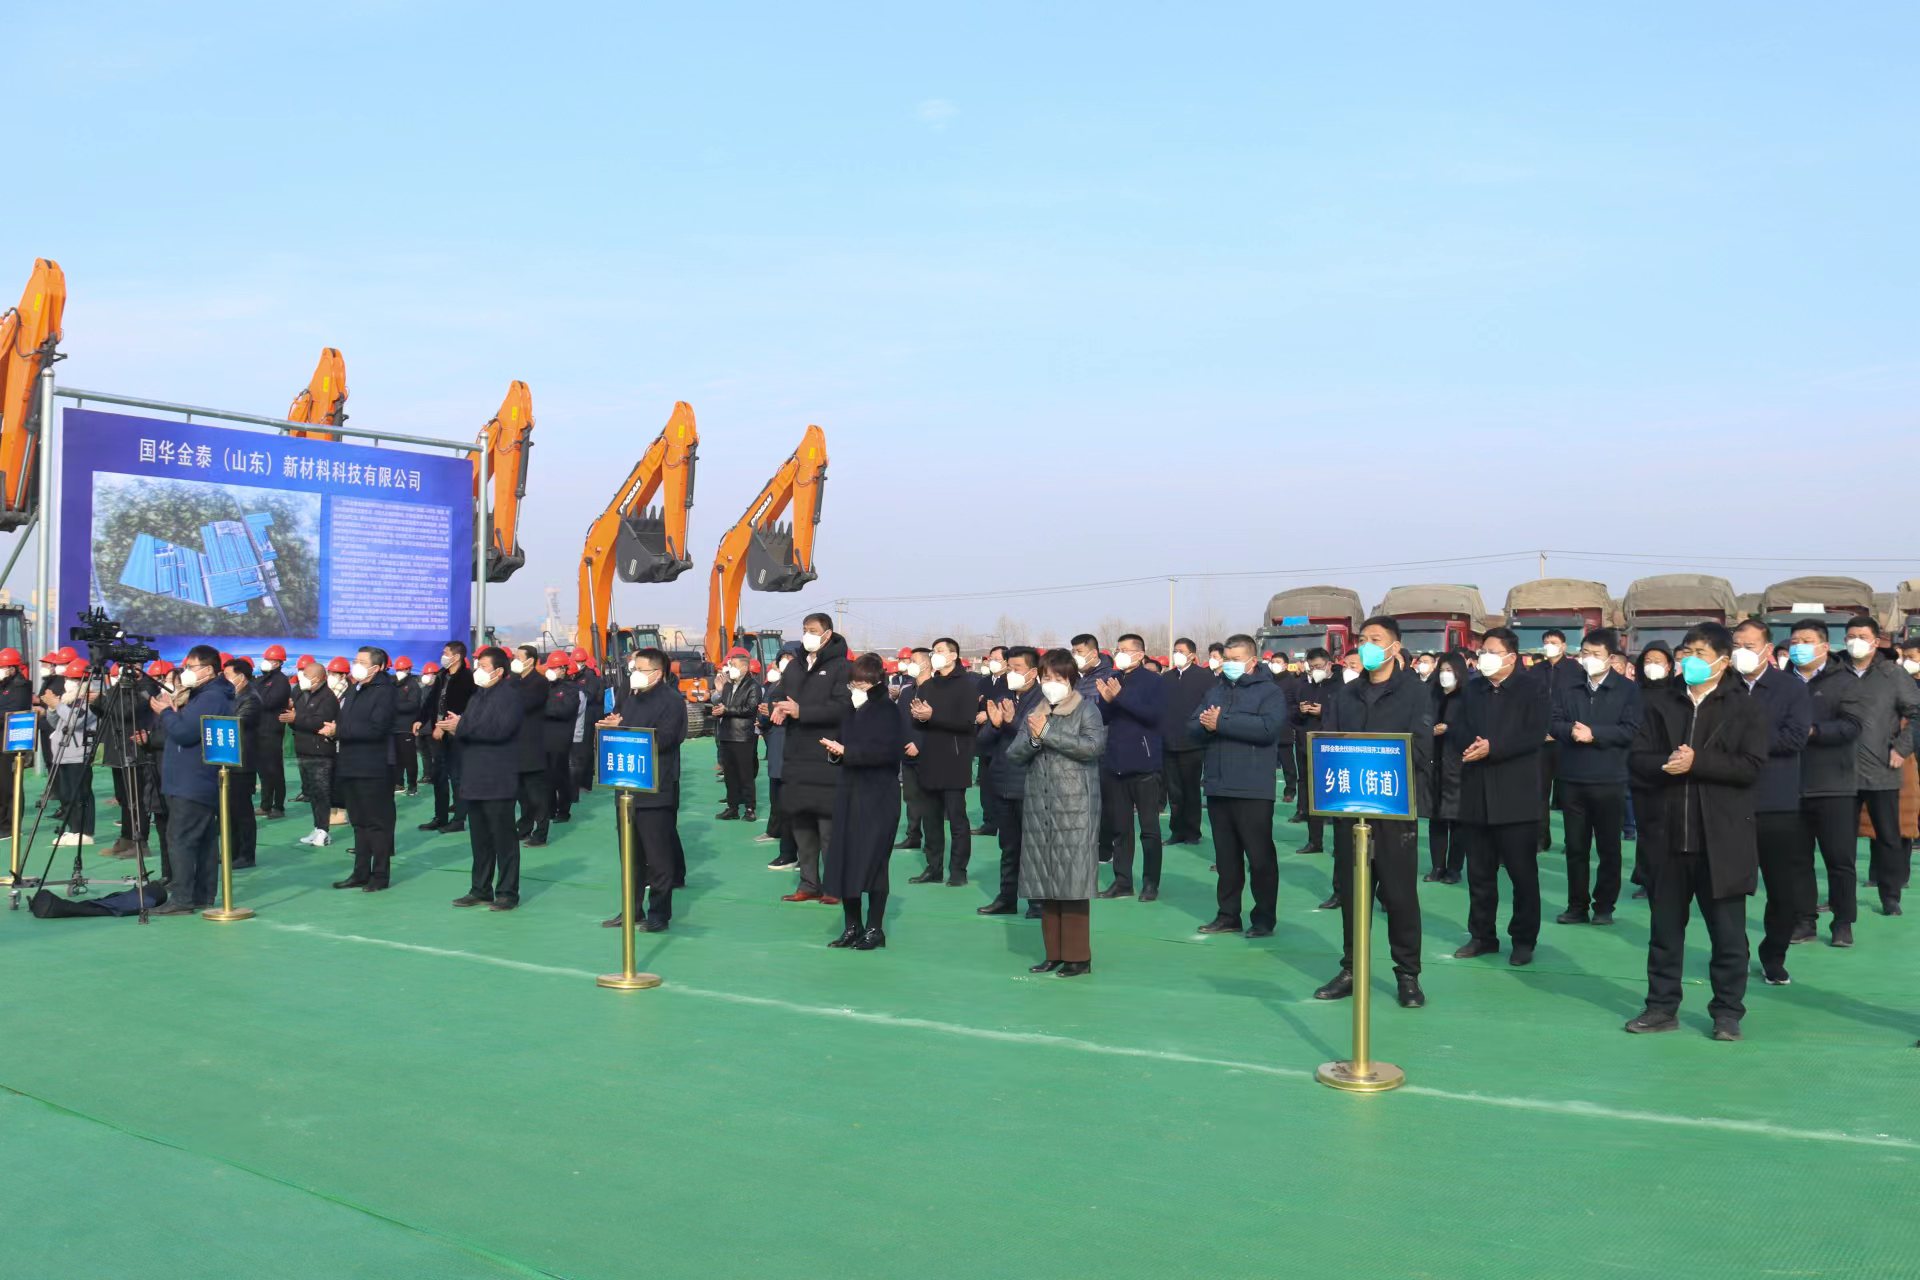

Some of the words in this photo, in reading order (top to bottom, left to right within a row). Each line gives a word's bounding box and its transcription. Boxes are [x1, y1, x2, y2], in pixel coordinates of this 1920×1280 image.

[606, 752, 646, 774] 县直部门
[1325, 767, 1399, 797] 乡镇（街道）
